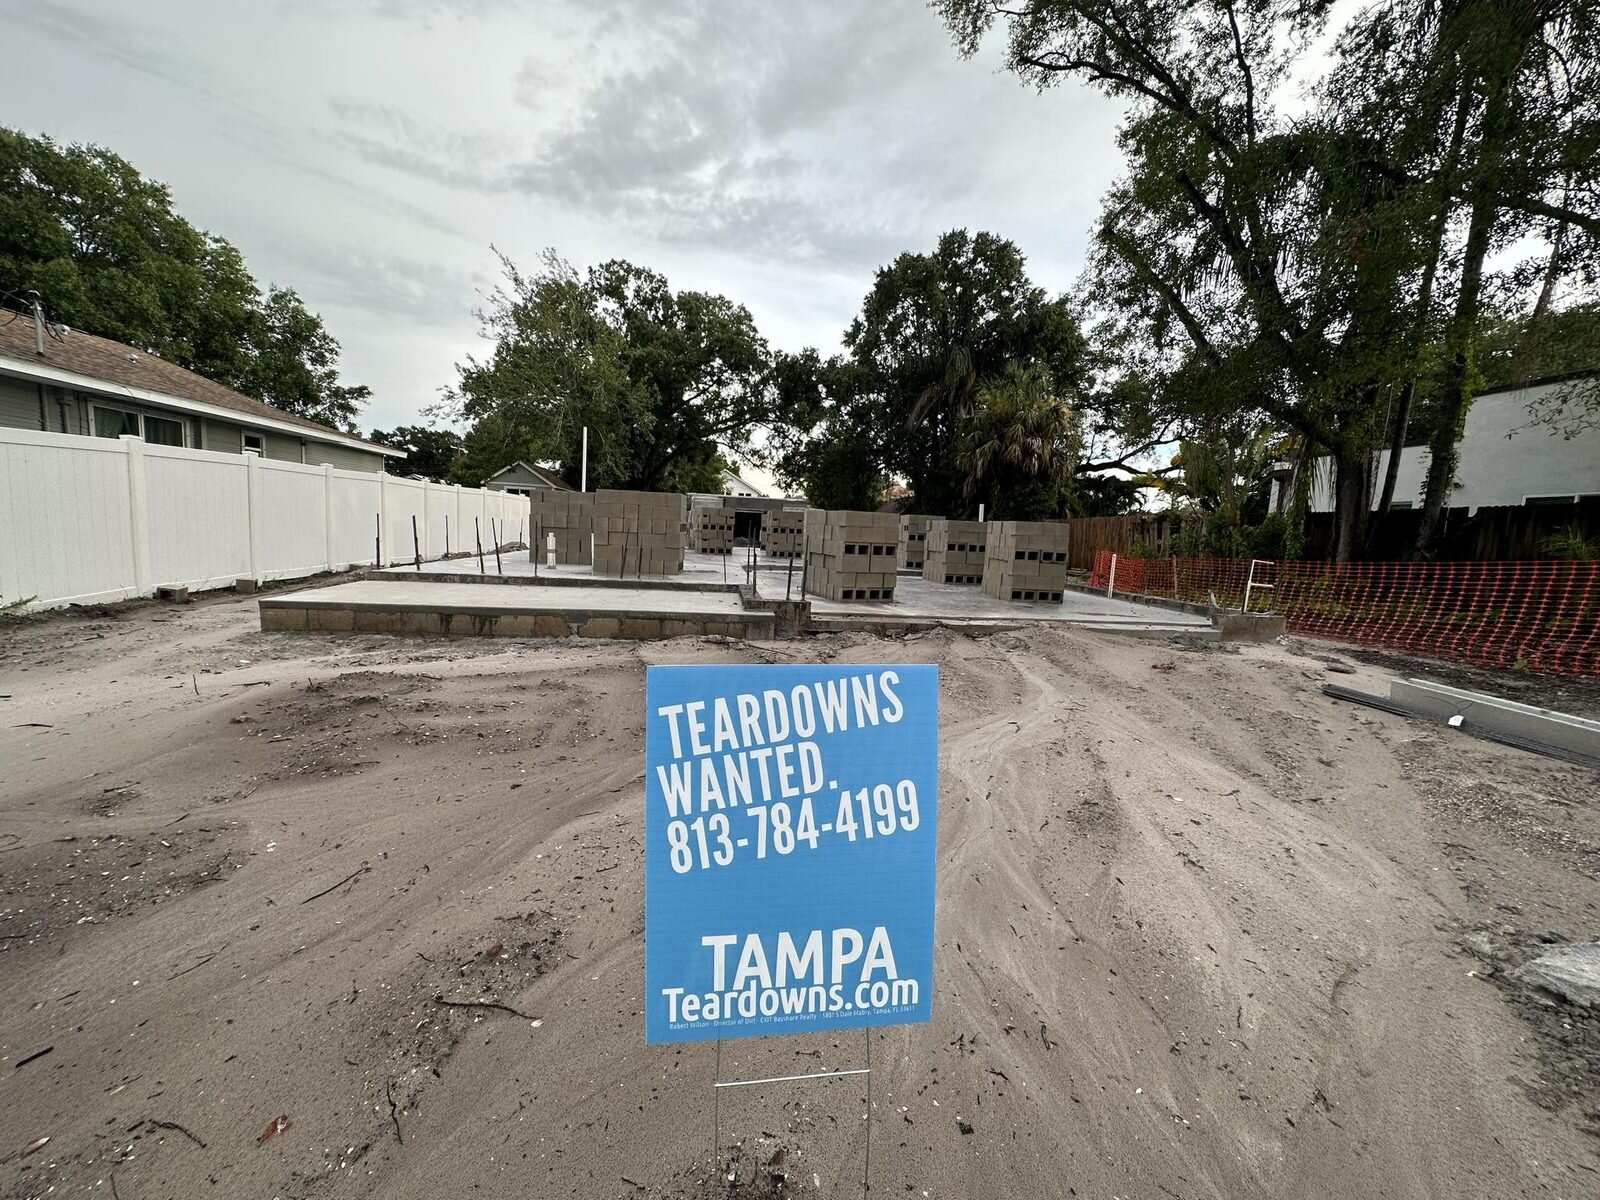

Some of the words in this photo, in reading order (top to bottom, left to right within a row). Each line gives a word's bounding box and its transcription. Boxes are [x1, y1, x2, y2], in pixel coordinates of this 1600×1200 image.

[658, 671, 903, 758] TEARDOWNS
[656, 741, 838, 817] WANTED.
[667, 779, 920, 873] 813-784-4199
[702, 926, 897, 991] TAMPA
[662, 978, 918, 1022] Teardowns.com
[690, 1021, 710, 1029] Wilson
[773, 1014, 799, 1022] Bayshore
